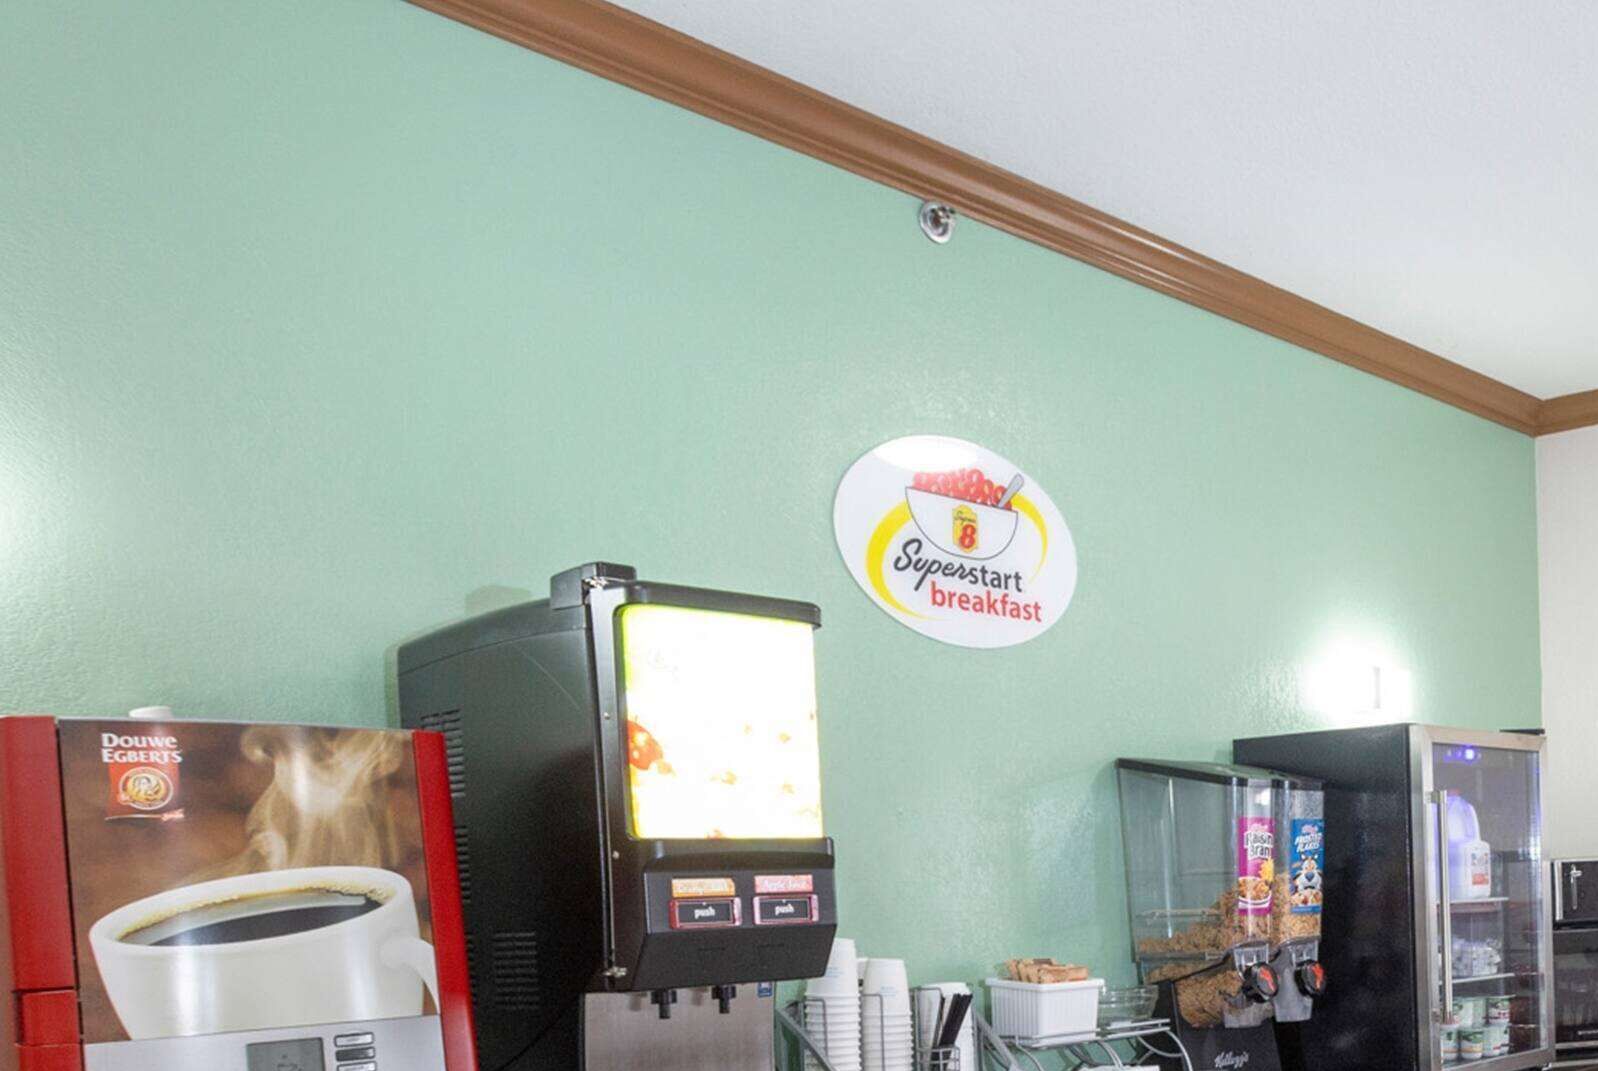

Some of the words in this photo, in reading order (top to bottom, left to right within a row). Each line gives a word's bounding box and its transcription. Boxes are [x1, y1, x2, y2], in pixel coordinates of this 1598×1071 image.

[959, 523, 976, 550] 8
[893, 538, 1023, 592] Superstart
[930, 580, 1043, 622] breakfast
[693, 906, 716, 919] push
[775, 904, 795, 916] push
